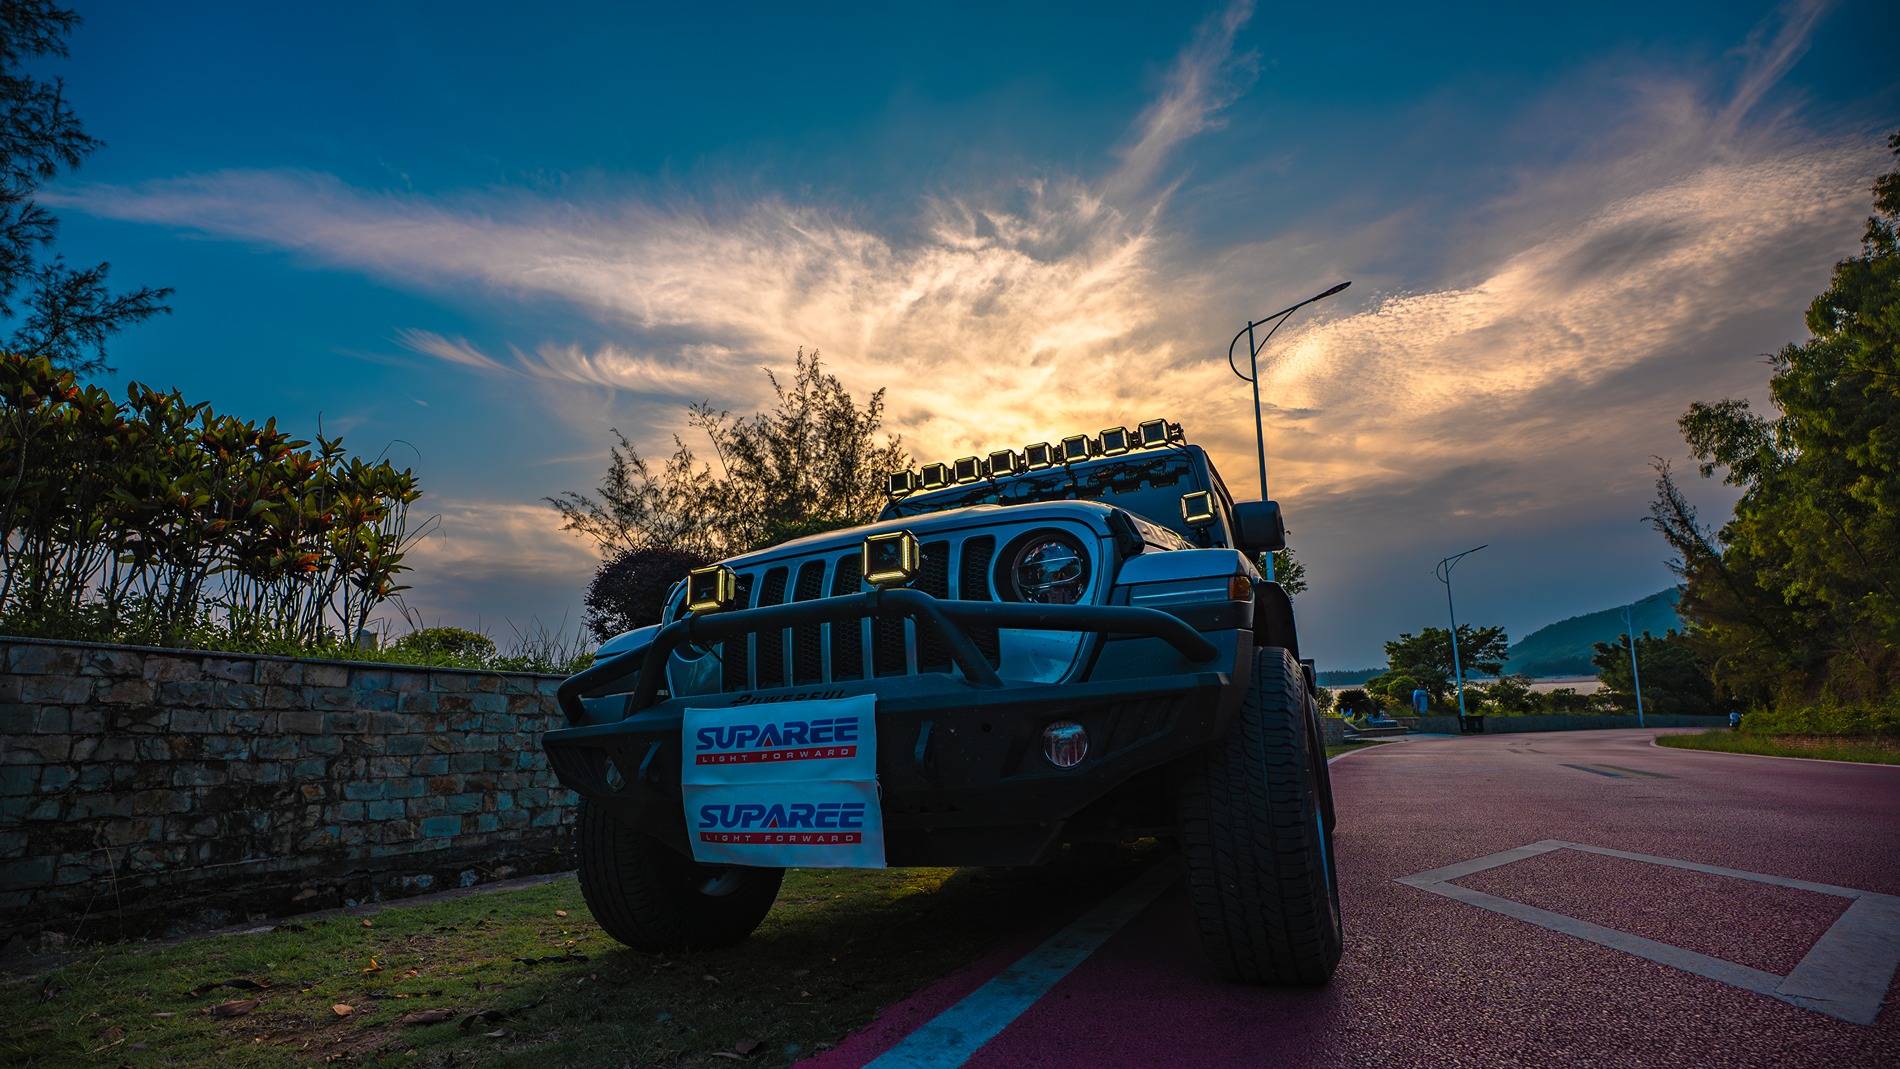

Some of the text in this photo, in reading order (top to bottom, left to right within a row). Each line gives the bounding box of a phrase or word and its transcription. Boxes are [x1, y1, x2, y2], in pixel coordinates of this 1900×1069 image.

[696, 716, 859, 750] SUPAREE
[702, 748, 849, 763] LIGHT FORWARD
[698, 802, 865, 829] SUPAREE
[705, 834, 854, 842] LIGHT FORWARD
